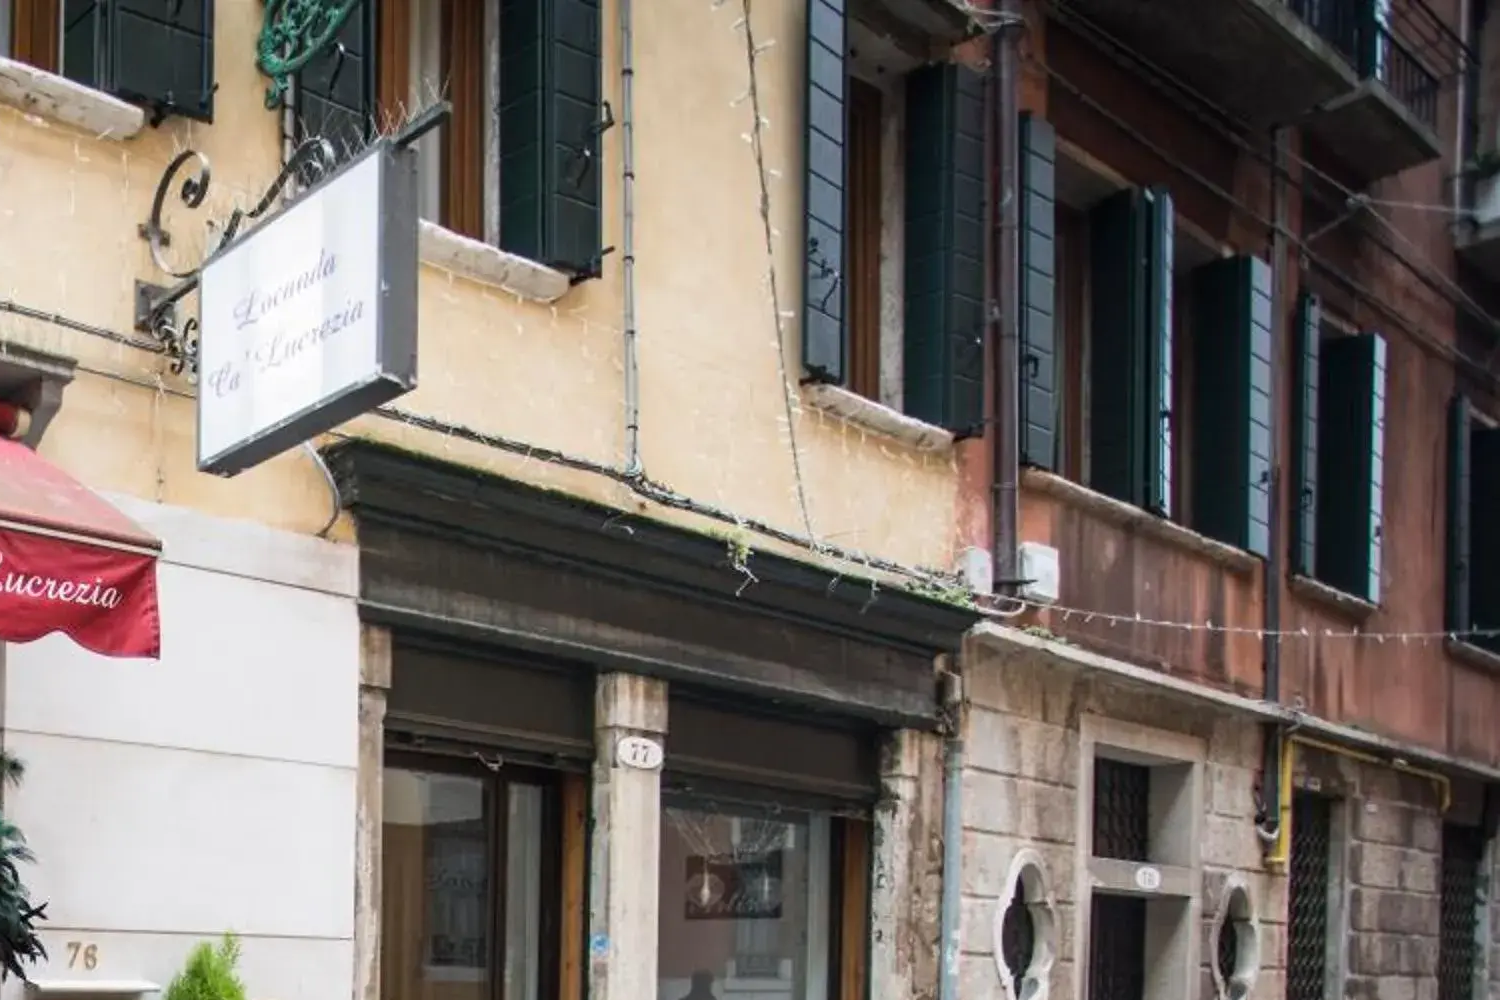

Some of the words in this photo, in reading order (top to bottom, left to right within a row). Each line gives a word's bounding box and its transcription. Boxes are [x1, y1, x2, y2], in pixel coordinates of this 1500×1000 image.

[233, 248, 336, 330] Locanda
[255, 299, 364, 373] Lucrezia
[631, 743, 650, 762] 77
[66, 941, 98, 970] 76
